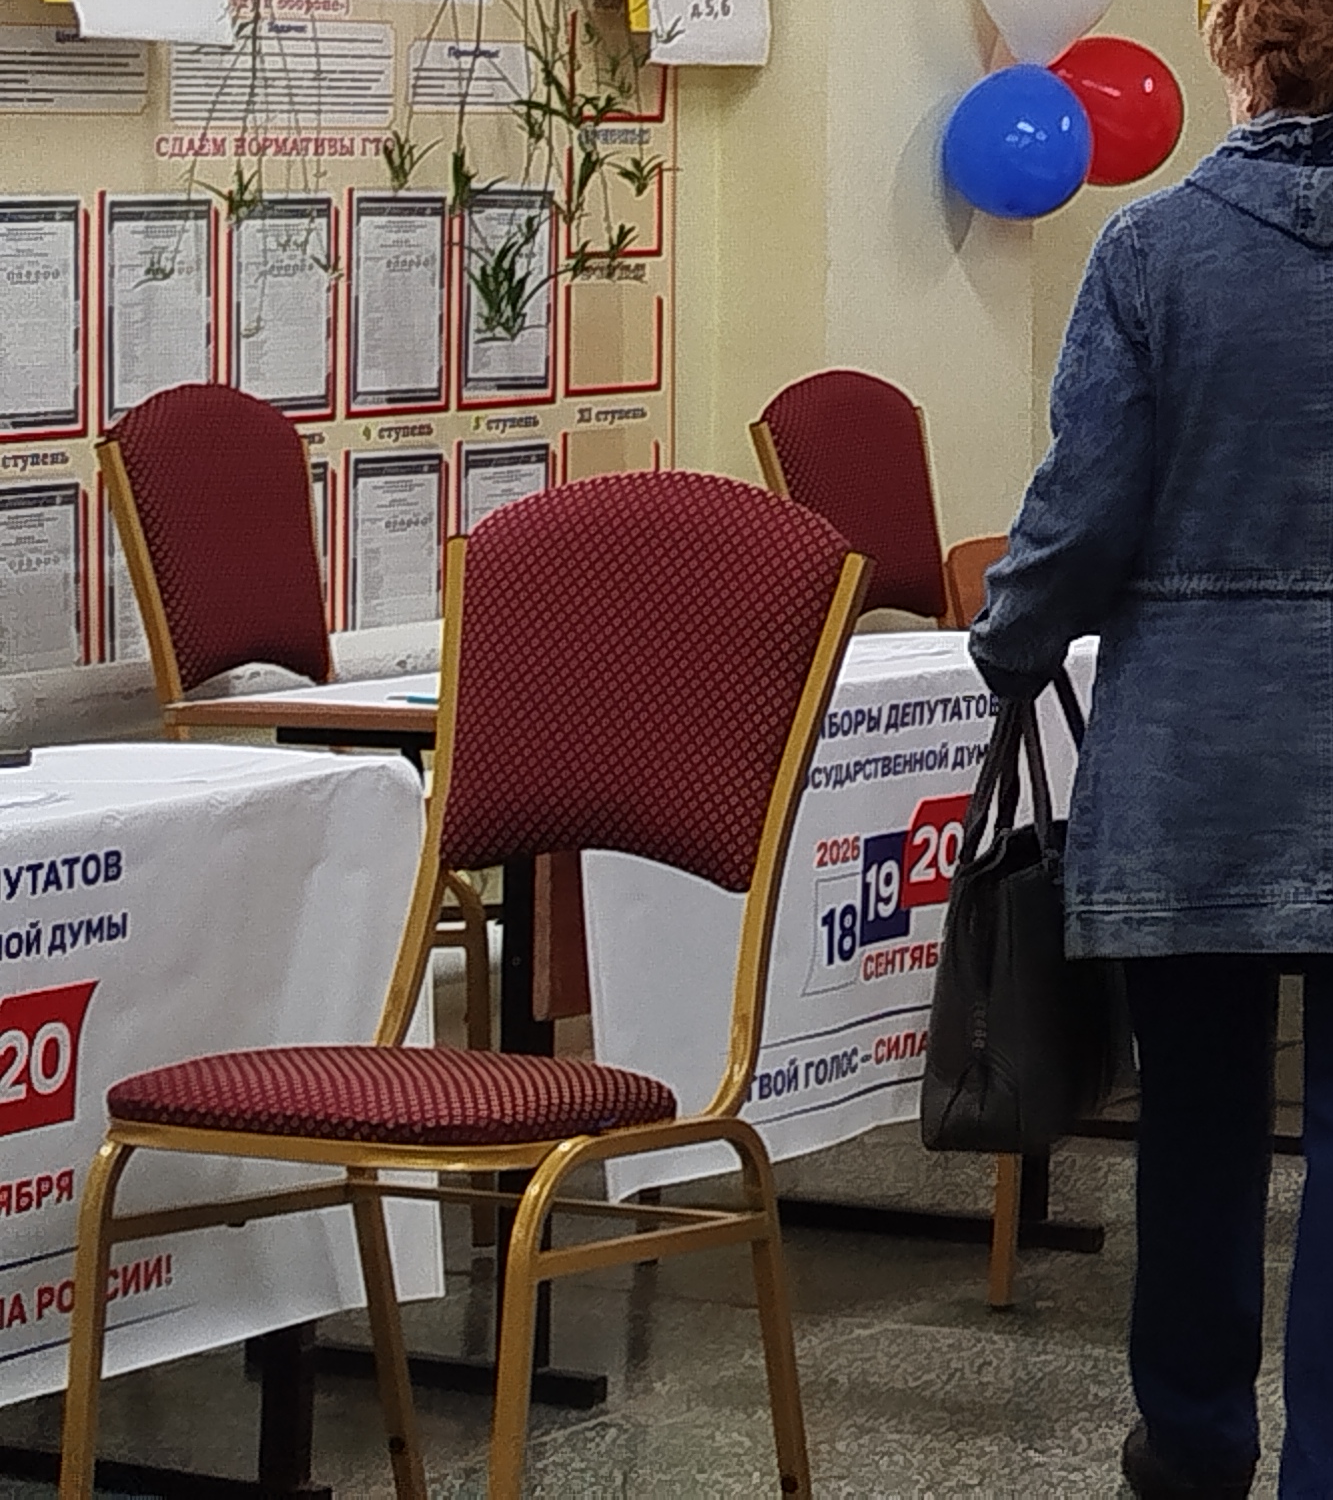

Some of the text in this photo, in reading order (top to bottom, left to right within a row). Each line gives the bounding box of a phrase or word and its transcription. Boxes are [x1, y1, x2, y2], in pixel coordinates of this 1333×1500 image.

[232, 136, 355, 159] НОРМАТИВЫ
[819, 707, 882, 740] БОРЫ
[804, 741, 949, 791] СУДАРСТВЕННОЙ
[816, 835, 861, 869] 2026
[3, 850, 123, 900] УТАТОВ
[821, 821, 965, 966] 18 19 20
[48, 912, 128, 957] ДУМЫ
[862, 942, 939, 982] СЕНТЯБ
[0, 1021, 71, 1104] 20
[804, 1046, 859, 1089] ГОЛОС
[36, 1253, 173, 1321] РОСИИ!
